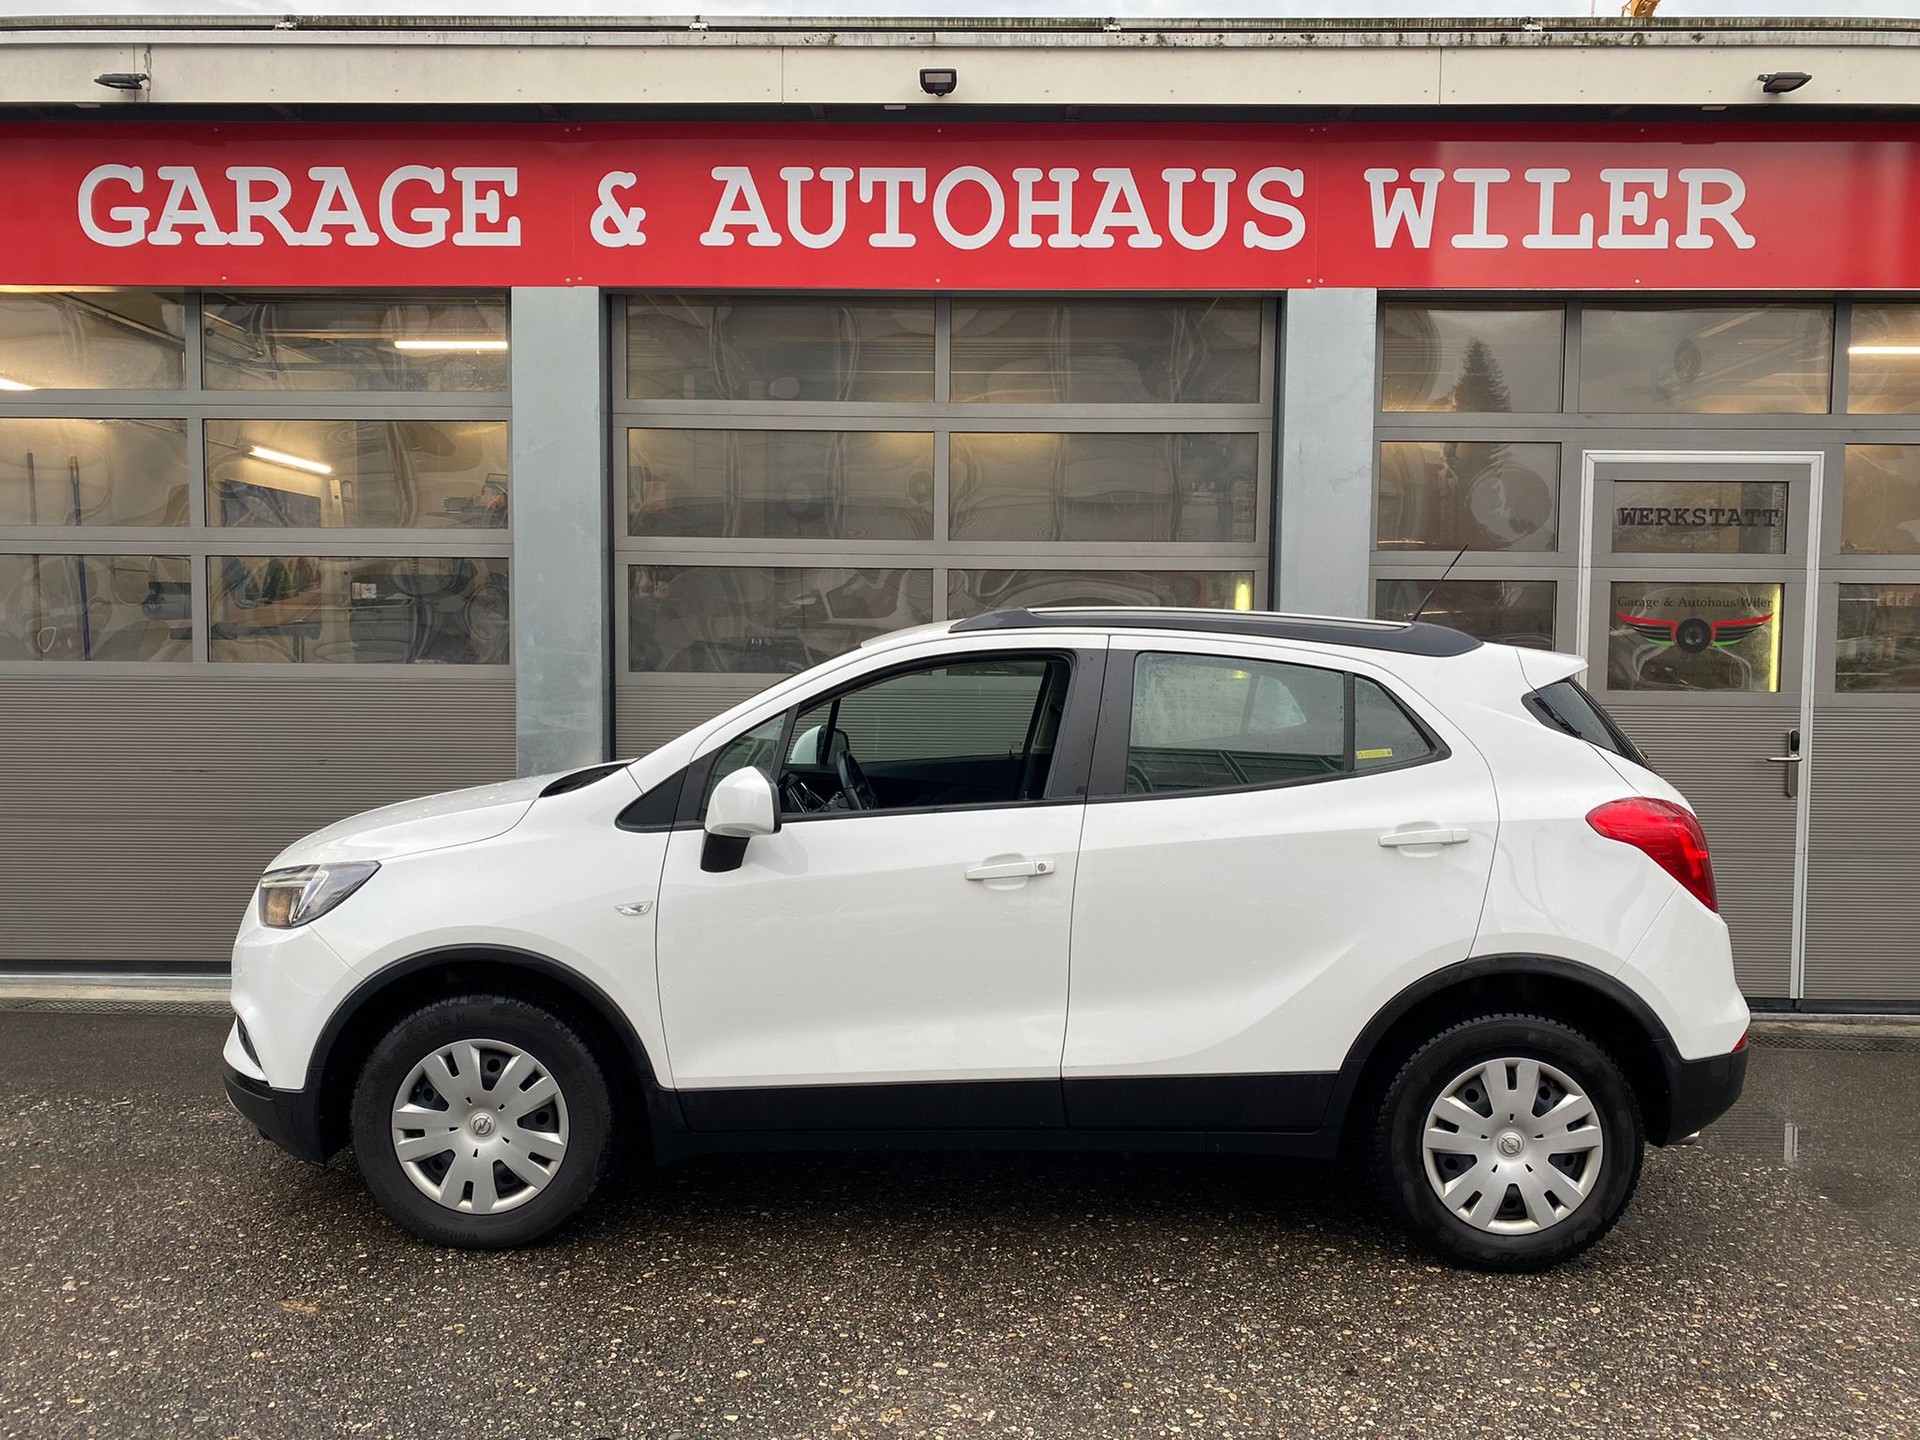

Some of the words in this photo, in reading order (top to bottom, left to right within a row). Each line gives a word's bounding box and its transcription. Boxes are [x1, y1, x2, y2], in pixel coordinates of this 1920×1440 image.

[77, 163, 521, 248] GARAGE
[589, 170, 647, 248] &
[699, 165, 1306, 250] AUTOHAUS
[1363, 167, 1757, 249] WILER
[1618, 507, 1779, 527] WERKSTATT
[1617, 596, 1660, 610] Garage
[1663, 597, 1673, 608] &
[1678, 597, 1736, 608] Autohaus
[1740, 597, 1773, 608] Wiler
